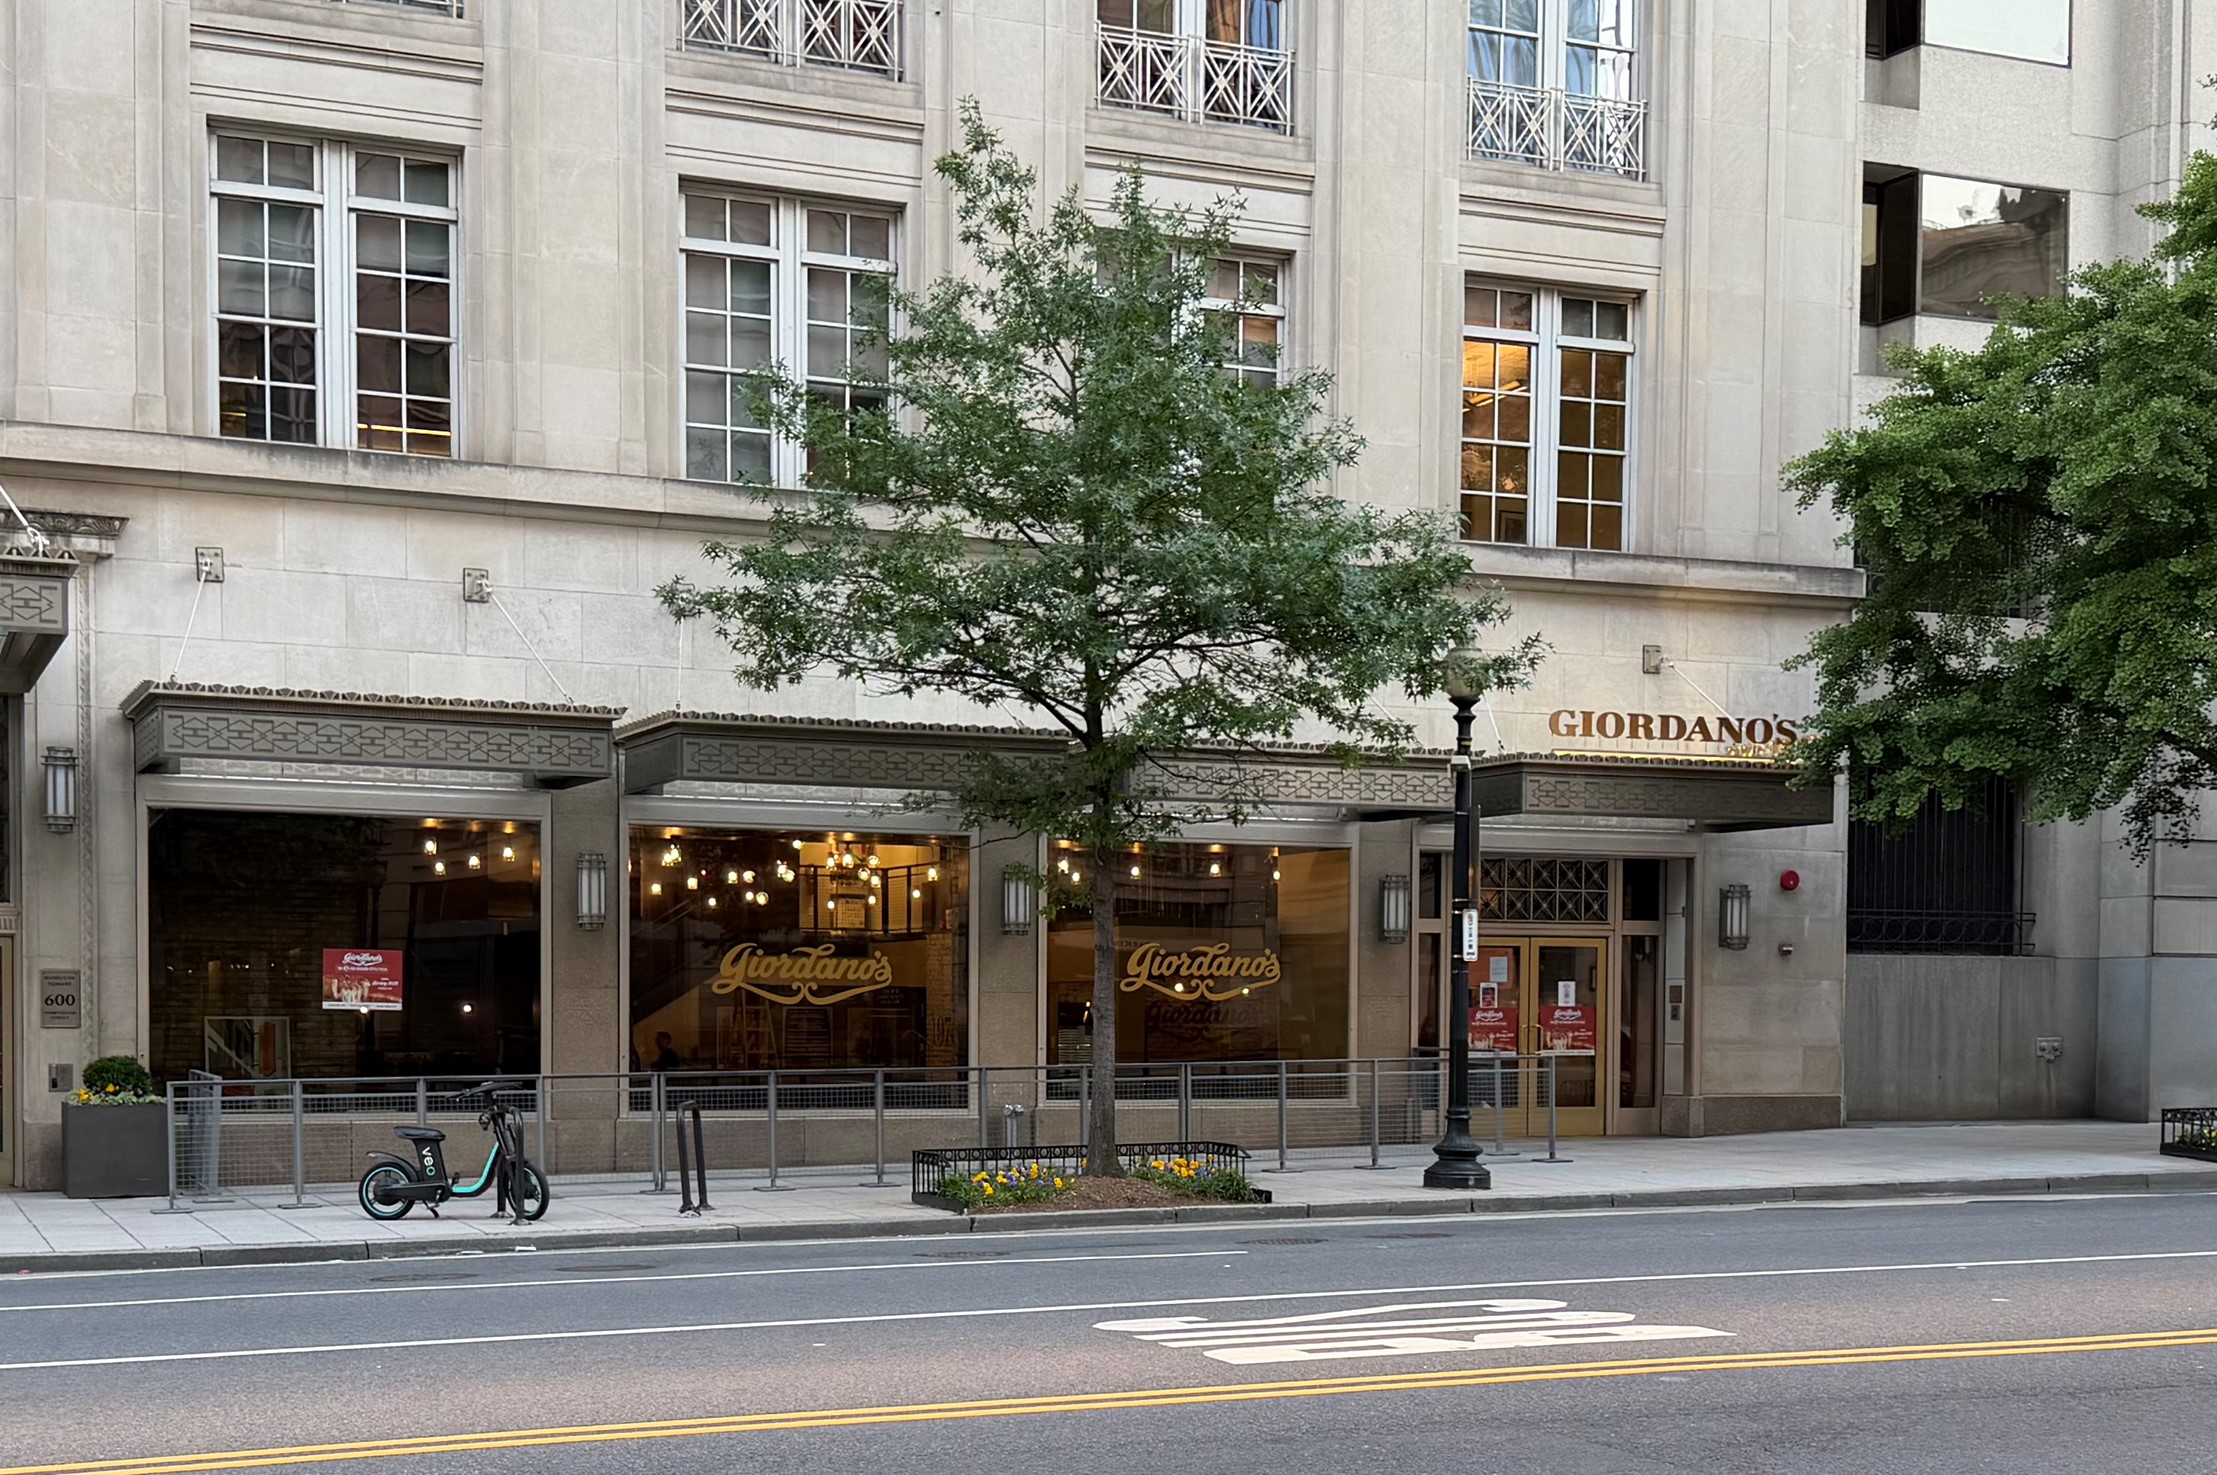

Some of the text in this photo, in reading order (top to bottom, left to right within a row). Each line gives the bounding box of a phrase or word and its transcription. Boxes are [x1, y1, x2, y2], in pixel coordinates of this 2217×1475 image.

[1548, 709, 1798, 746] GIORDANO'S
[711, 943, 892, 1005] Giordano's
[1119, 943, 1281, 1001] Giordano's
[44, 994, 76, 1006] 600
[422, 1146, 435, 1176] veo
